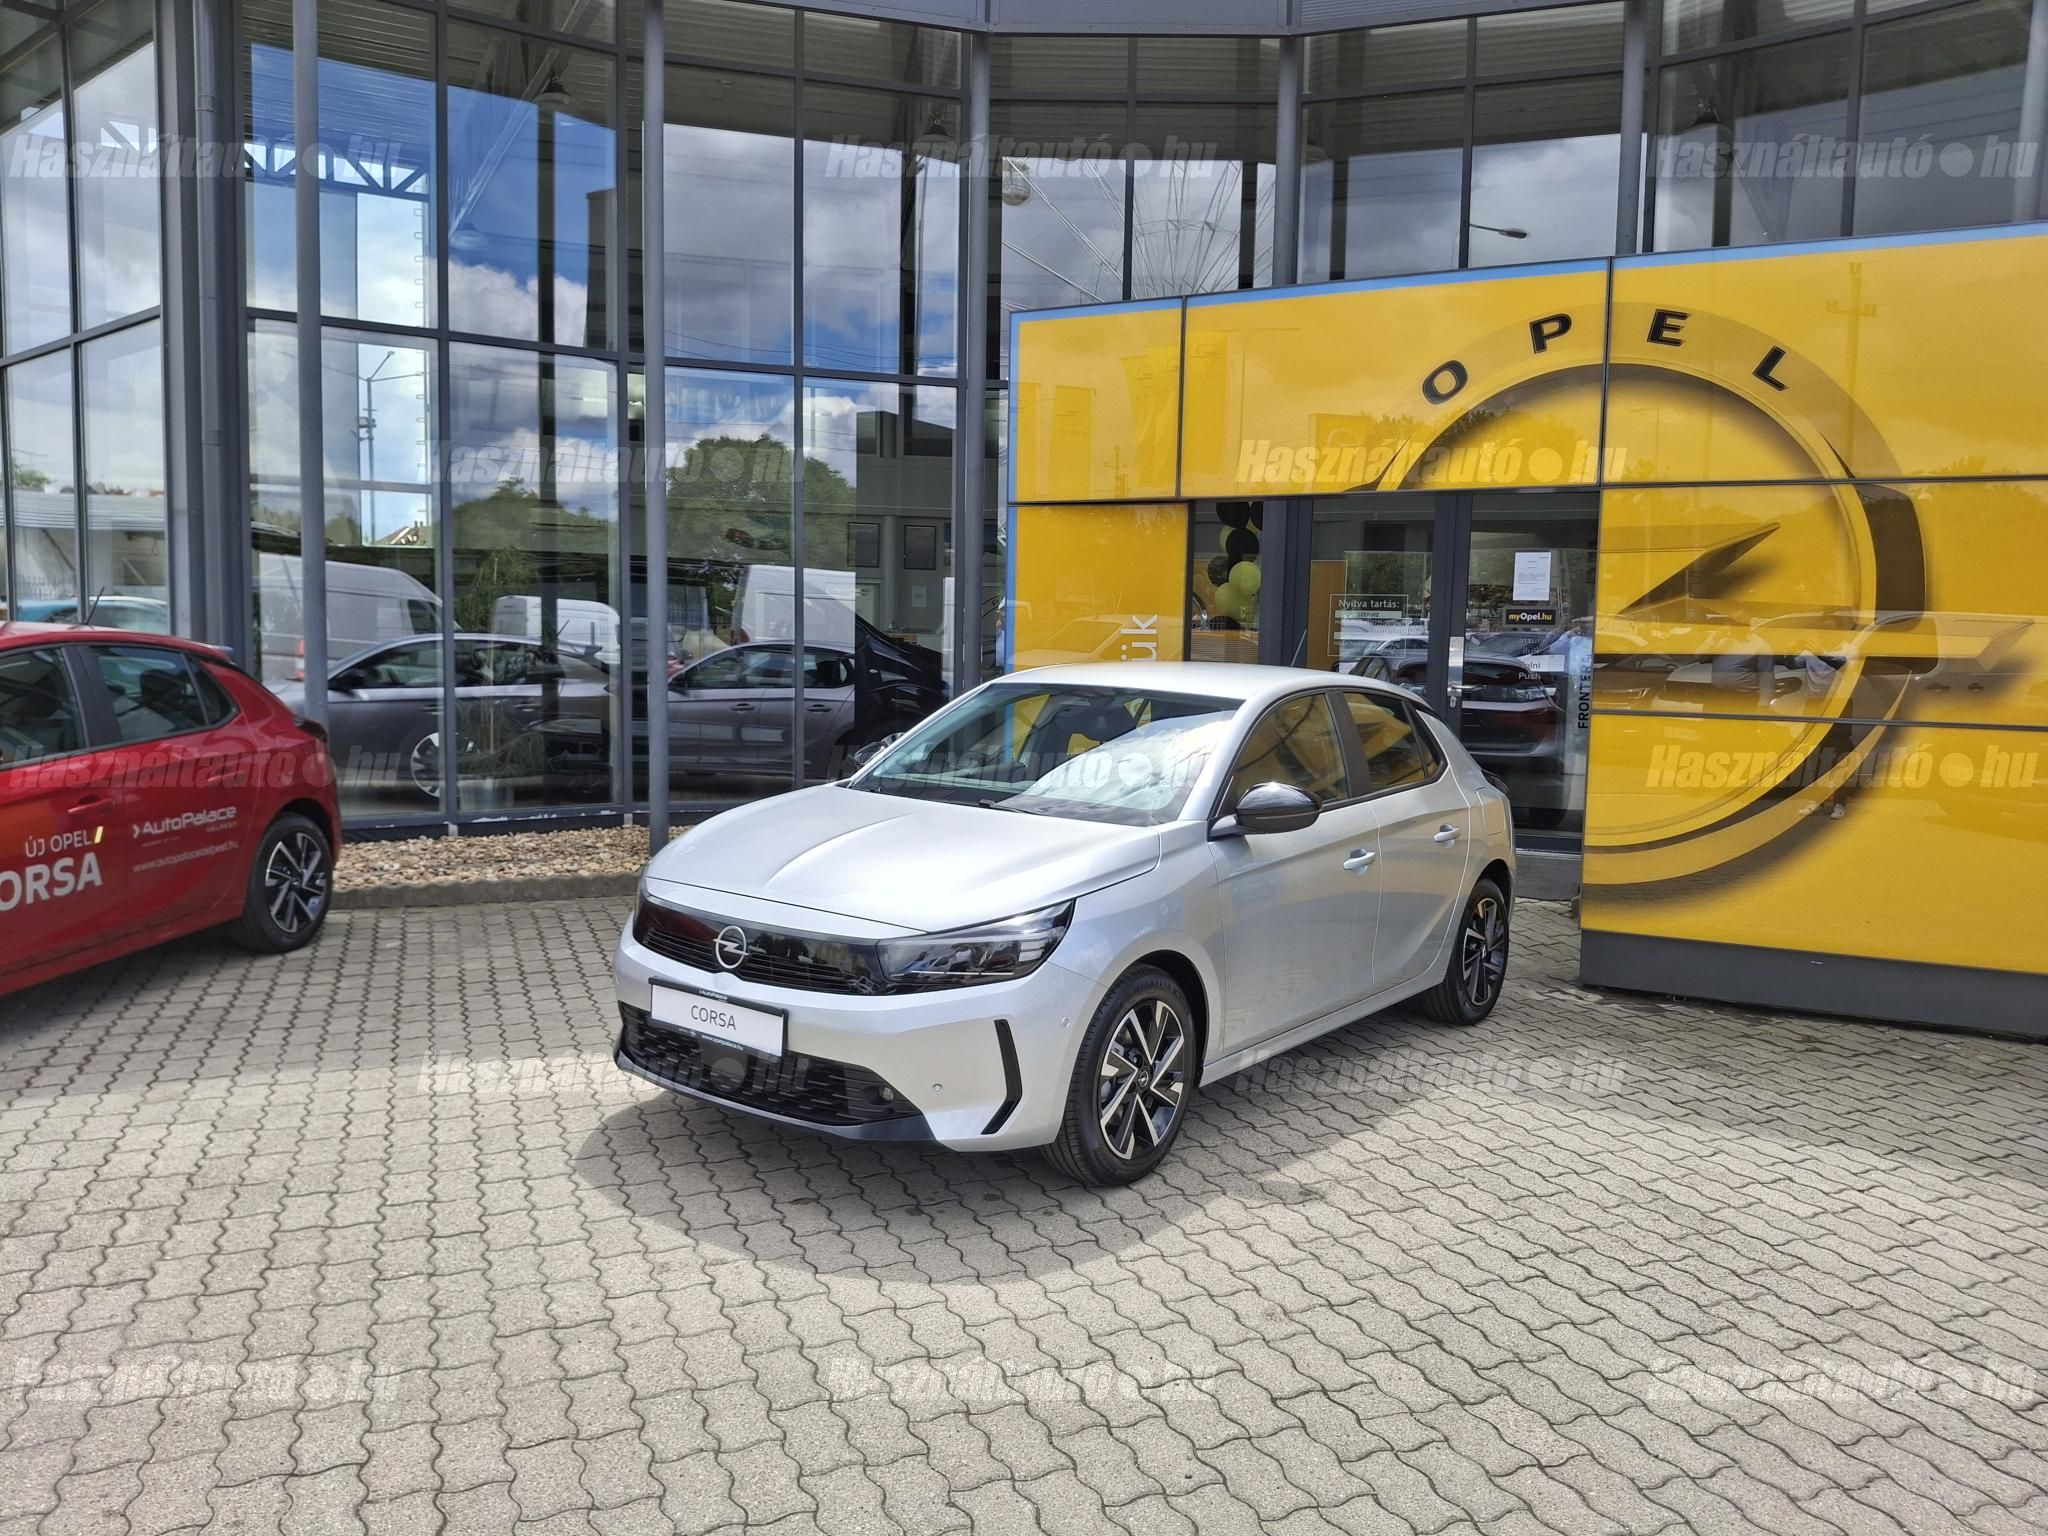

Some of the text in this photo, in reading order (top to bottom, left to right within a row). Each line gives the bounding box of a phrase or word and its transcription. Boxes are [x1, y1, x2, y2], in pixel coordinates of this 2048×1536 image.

[1422, 308, 1788, 405] OPEL
[1338, 599, 1400, 609] Nyitva tartás:
[1508, 611, 1553, 623] myOpel.hu
[1518, 671, 1541, 681] Push
[142, 805, 237, 835] AutoPalace
[24, 829, 92, 858] ÚJ OPEL
[690, 1004, 737, 1031] CORSA
